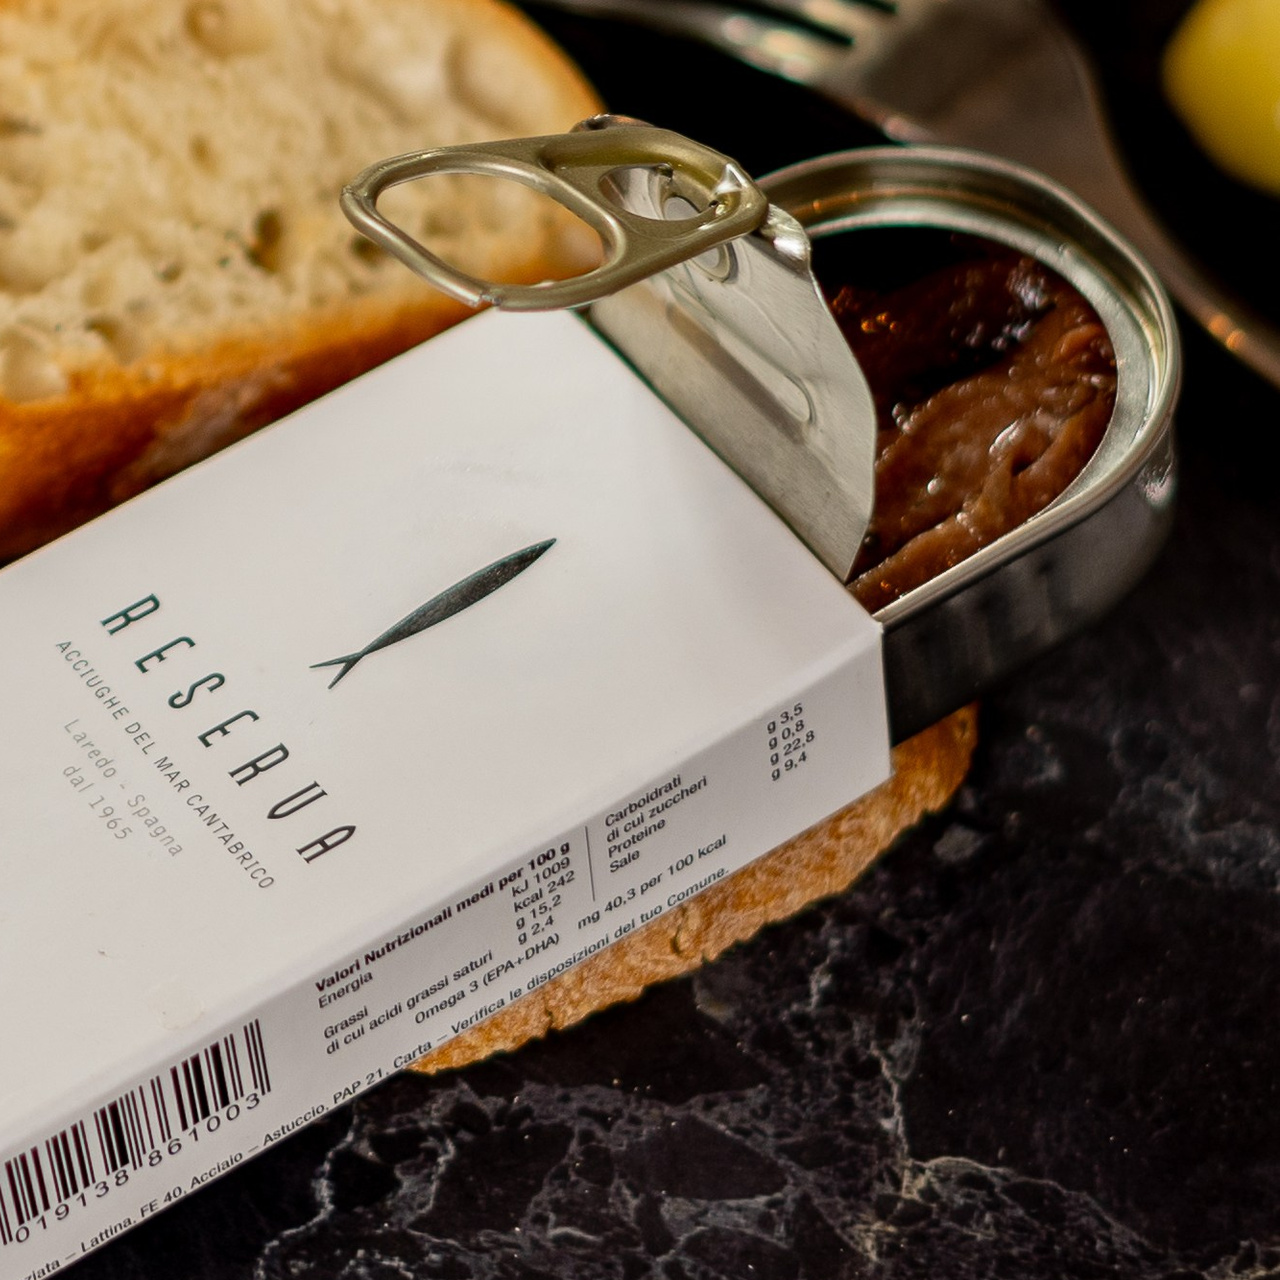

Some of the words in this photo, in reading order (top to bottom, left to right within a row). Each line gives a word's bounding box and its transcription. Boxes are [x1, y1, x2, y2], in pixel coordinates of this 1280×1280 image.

[100, 594, 357, 864] RESERVA
[767, 721, 776, 734] g
[780, 703, 802, 724] 3,5
[769, 737, 777, 750] g
[782, 720, 804, 740] 0,8
[56, 641, 129, 720] ACCIUGHE
[125, 722, 155, 755] DEL
[154, 757, 190, 792] MAR
[187, 795, 274, 888] CANTABRICO
[770, 753, 779, 766] g
[784, 730, 815, 756] 22,8
[772, 768, 780, 781] g
[785, 752, 806, 771] 9,4
[63, 766, 94, 792] dal
[89, 796, 133, 839] 1965
[64, 719, 116, 778] Laredo
[127, 795, 182, 856] Spagna
[605, 775, 681, 826] Carboidrati
[607, 828, 619, 842] di
[624, 812, 644, 832] cui
[649, 776, 707, 818] zuccheri
[609, 819, 665, 858] Proteine
[610, 850, 639, 873] Sale
[512, 879, 528, 897] kJ
[534, 857, 570, 883] 1009
[514, 888, 543, 913] kcal
[548, 871, 575, 893] 242
[578, 911, 600, 929] mg
[605, 888, 635, 911] 40,3
[641, 873, 662, 895] per
[669, 854, 693, 875] 100
[698, 835, 726, 858] kcal
[316, 959, 360, 992] Valori
[365, 907, 452, 965] Nutrizionali
[457, 882, 494, 912] medi
[499, 868, 523, 890] per
[529, 849, 555, 870] 100
[560, 842, 570, 855] g
[516, 917, 525, 930] g
[531, 895, 561, 918] 15,2
[518, 932, 527, 945] g
[531, 915, 554, 935] 2,4
[319, 972, 372, 1008] Energia
[416, 990, 464, 1023] Omega
[470, 981, 478, 992] 3
[483, 933, 559, 986] (EPA+DHA)
[325, 1006, 368, 1039] Grassi
[327, 1039, 339, 1054] di
[344, 1025, 364, 1044] cui
[369, 1003, 402, 1030] acidi
[407, 976, 449, 1010] grassi
[453, 951, 492, 981] saturi
[81, 1218, 136, 1252] Lattina,
[141, 1199, 157, 1217] FE
[164, 1187, 186, 1202] 40,
[191, 1153, 242, 1188] Acciaio
[264, 1105, 331, 1146] Astuccio,
[334, 1081, 361, 1104] PAP
[394, 1042, 431, 1068] Carta
[452, 999, 504, 1033] Verifica
[510, 988, 521, 1000] le
[527, 934, 609, 989] disposizioni
[614, 919, 635, 938] del
[641, 905, 662, 923] tuo
[667, 868, 728, 906] Comune.
[16, 1169, 128, 1243] 019138
[149, 1093, 259, 1167] 861003
